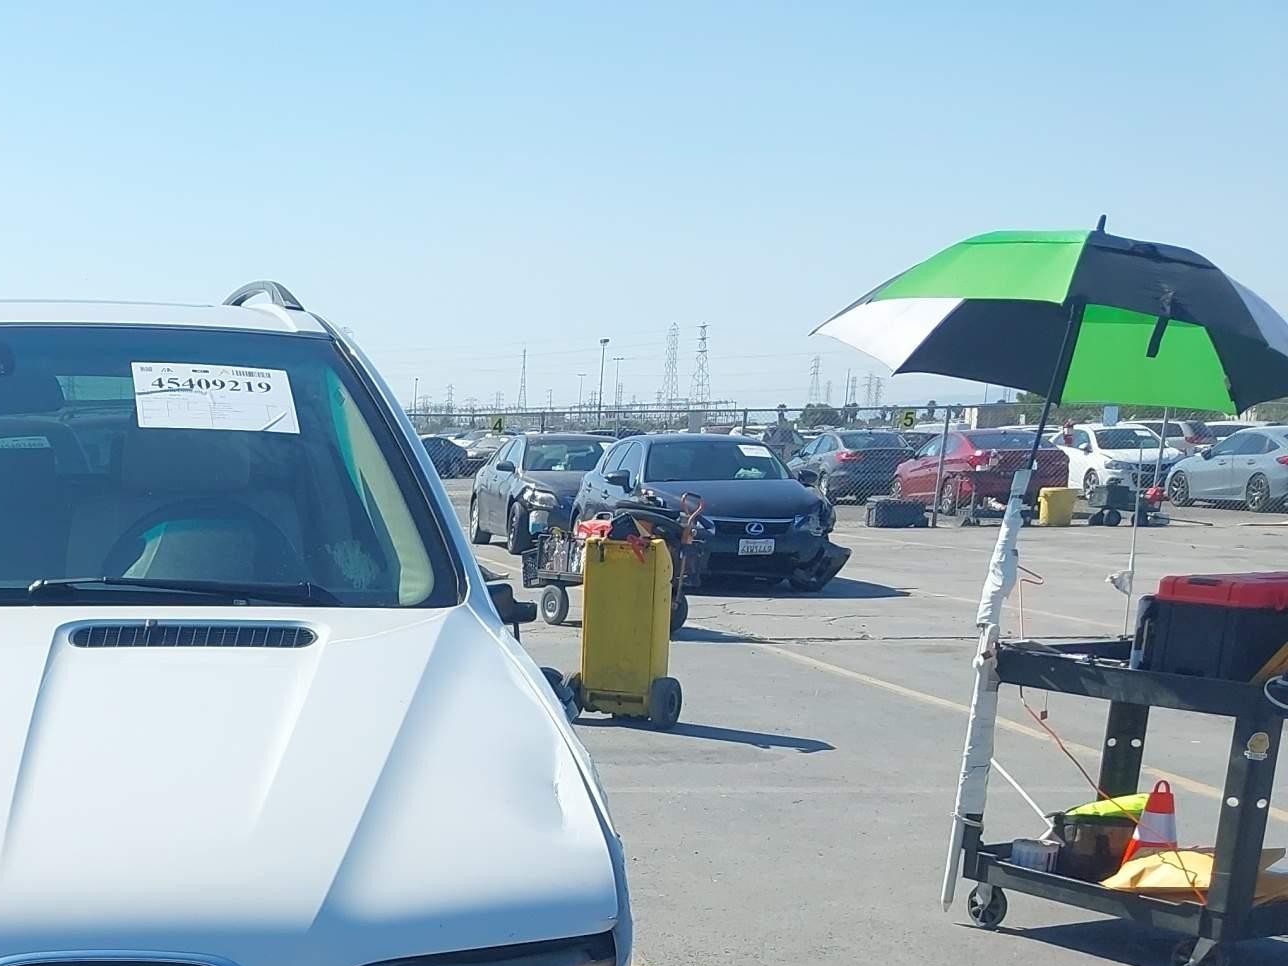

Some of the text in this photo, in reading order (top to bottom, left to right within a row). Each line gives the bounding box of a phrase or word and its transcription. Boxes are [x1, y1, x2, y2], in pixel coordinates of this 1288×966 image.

[151, 377, 272, 394] 45409219
[493, 418, 502, 433] 4
[903, 411, 914, 427] 5
